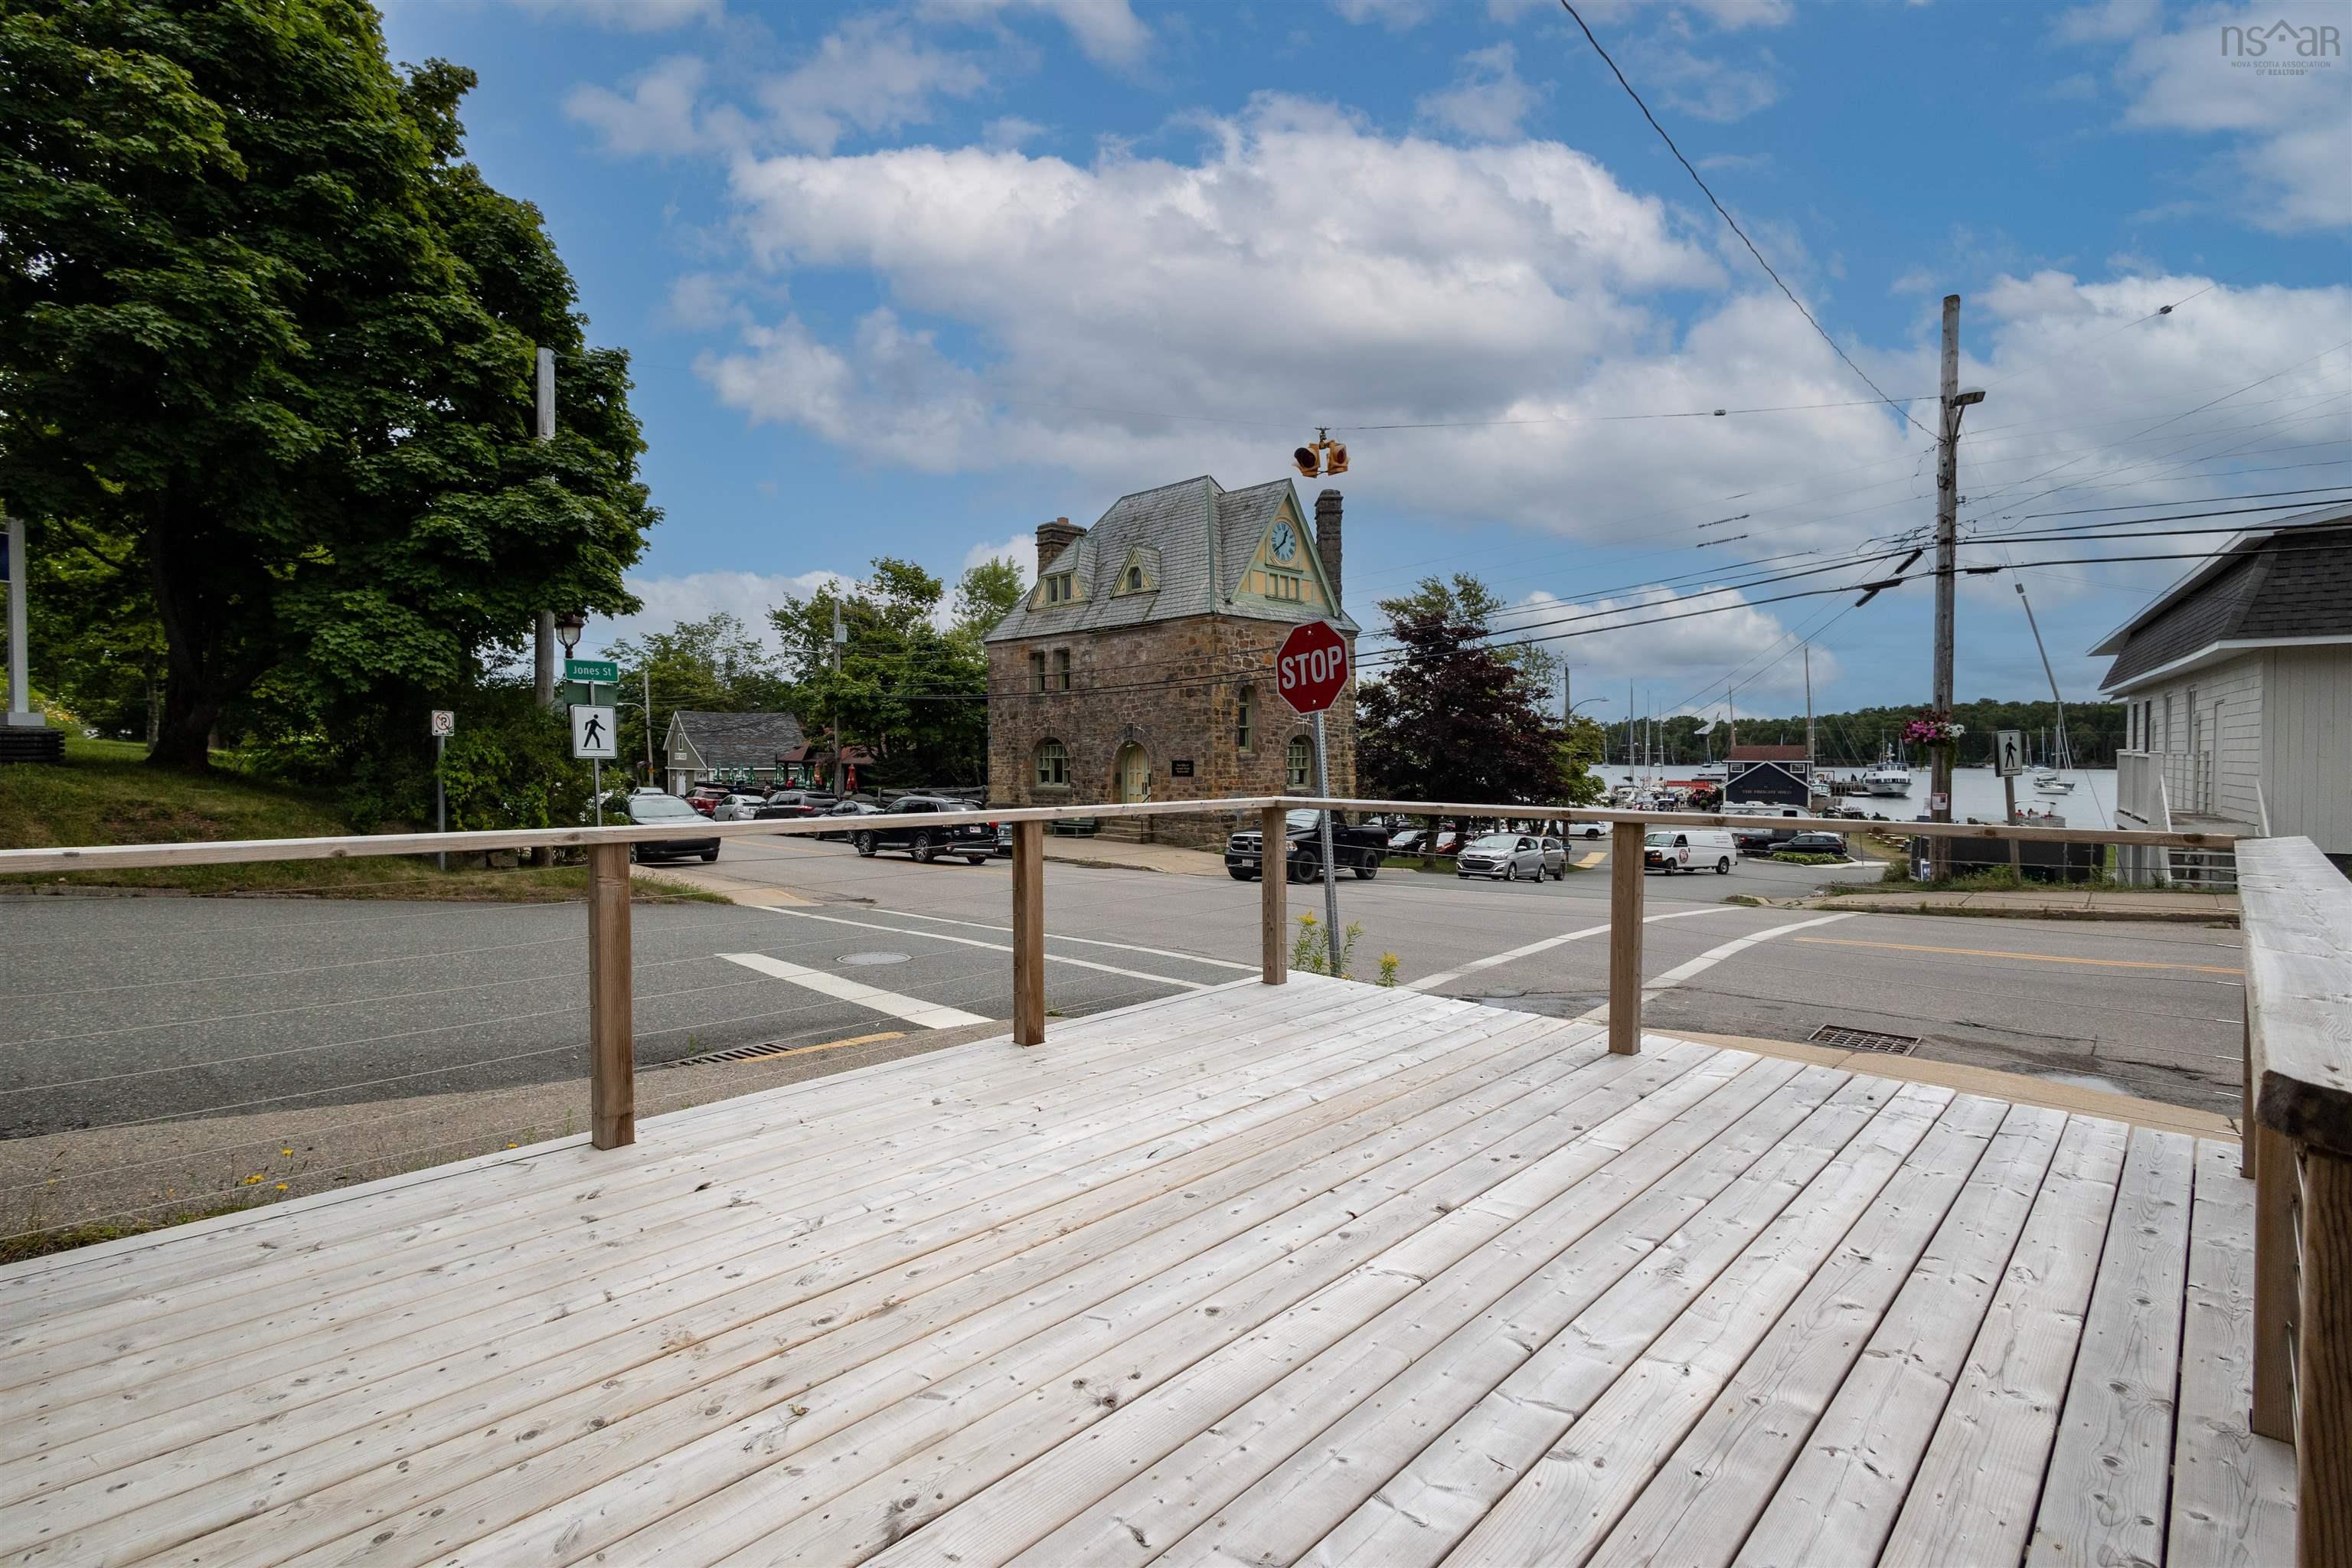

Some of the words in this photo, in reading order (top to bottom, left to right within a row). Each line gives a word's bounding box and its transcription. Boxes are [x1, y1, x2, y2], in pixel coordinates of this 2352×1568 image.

[573, 665, 599, 675] Jones
[603, 667, 612, 676] St
[1281, 645, 1342, 689] STOP
